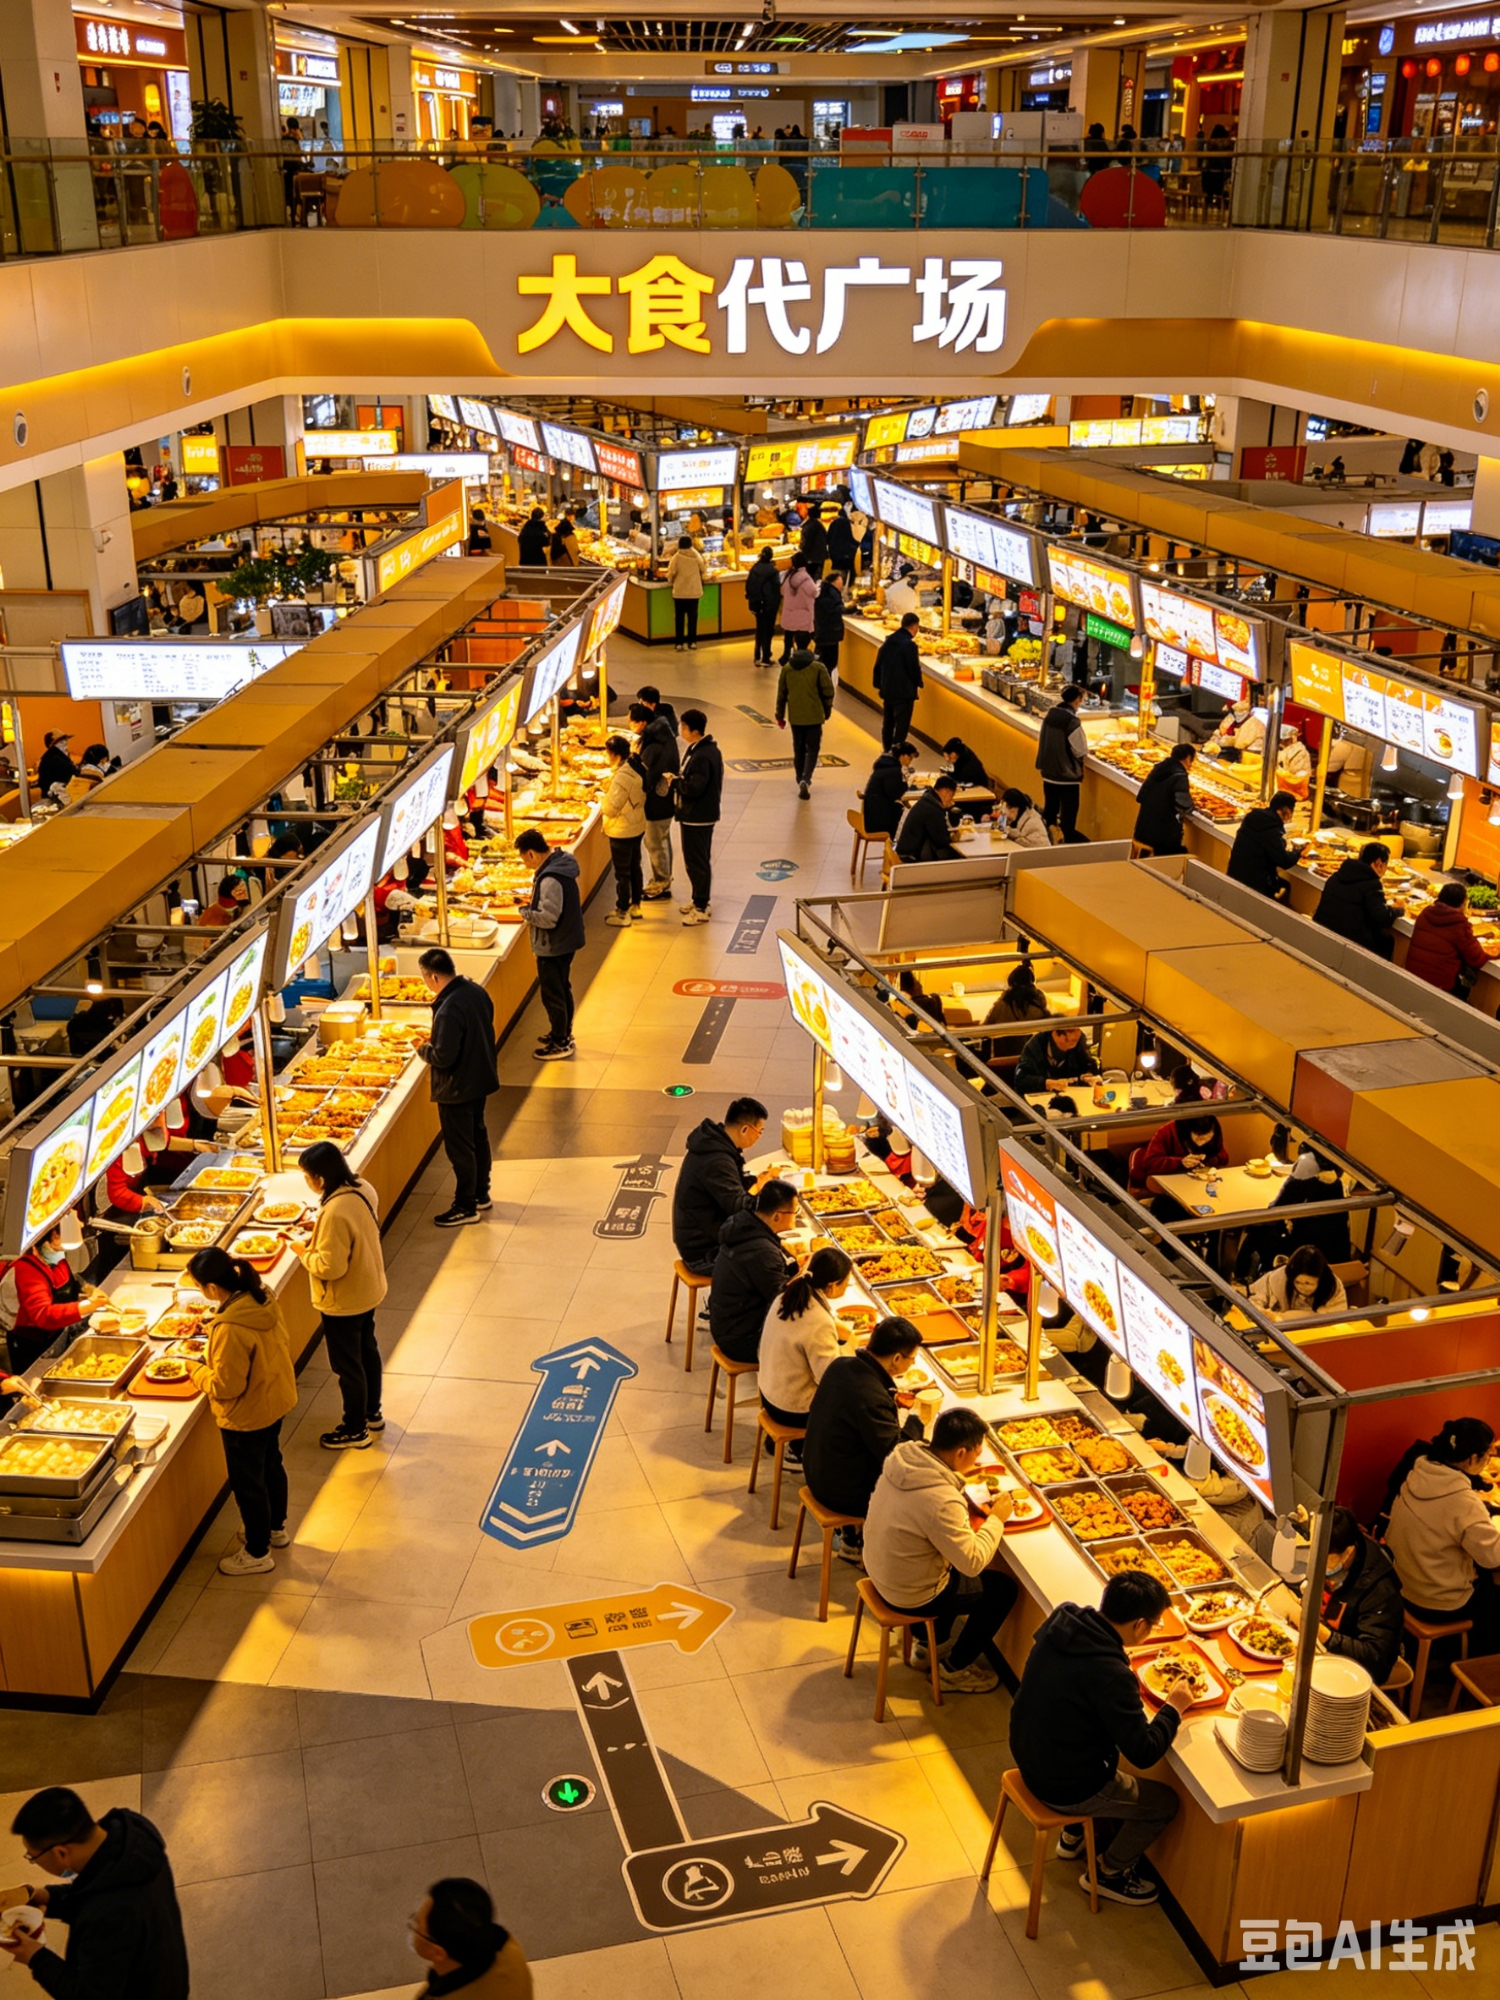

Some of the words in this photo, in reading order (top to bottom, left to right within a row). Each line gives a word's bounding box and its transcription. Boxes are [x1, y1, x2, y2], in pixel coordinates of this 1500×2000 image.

[517, 254, 1007, 355] 大食代广场
